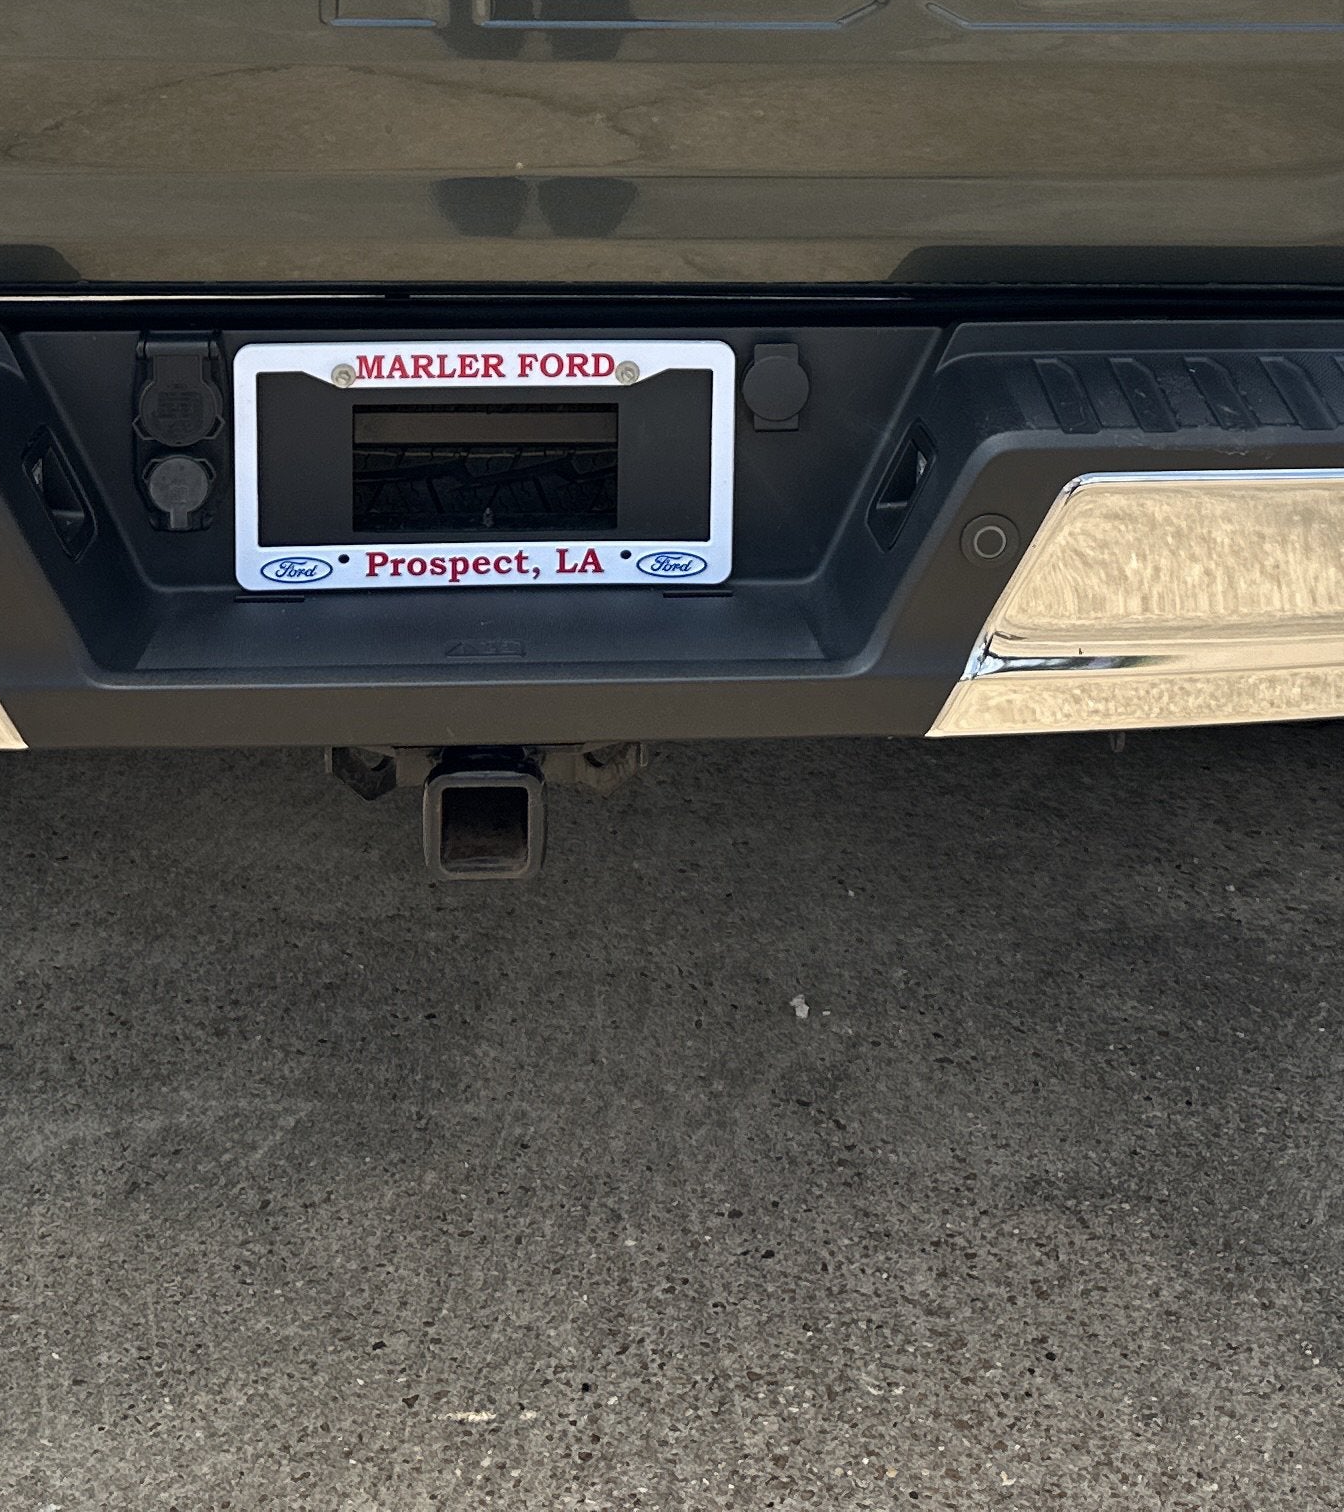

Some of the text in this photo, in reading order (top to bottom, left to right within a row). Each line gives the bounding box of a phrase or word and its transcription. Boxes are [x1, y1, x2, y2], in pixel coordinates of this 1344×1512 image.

[355, 352, 616, 380] MARLER FORD
[274, 558, 318, 578] Ford
[365, 548, 605, 582] Prospect, LA
[649, 554, 694, 574] Ford
